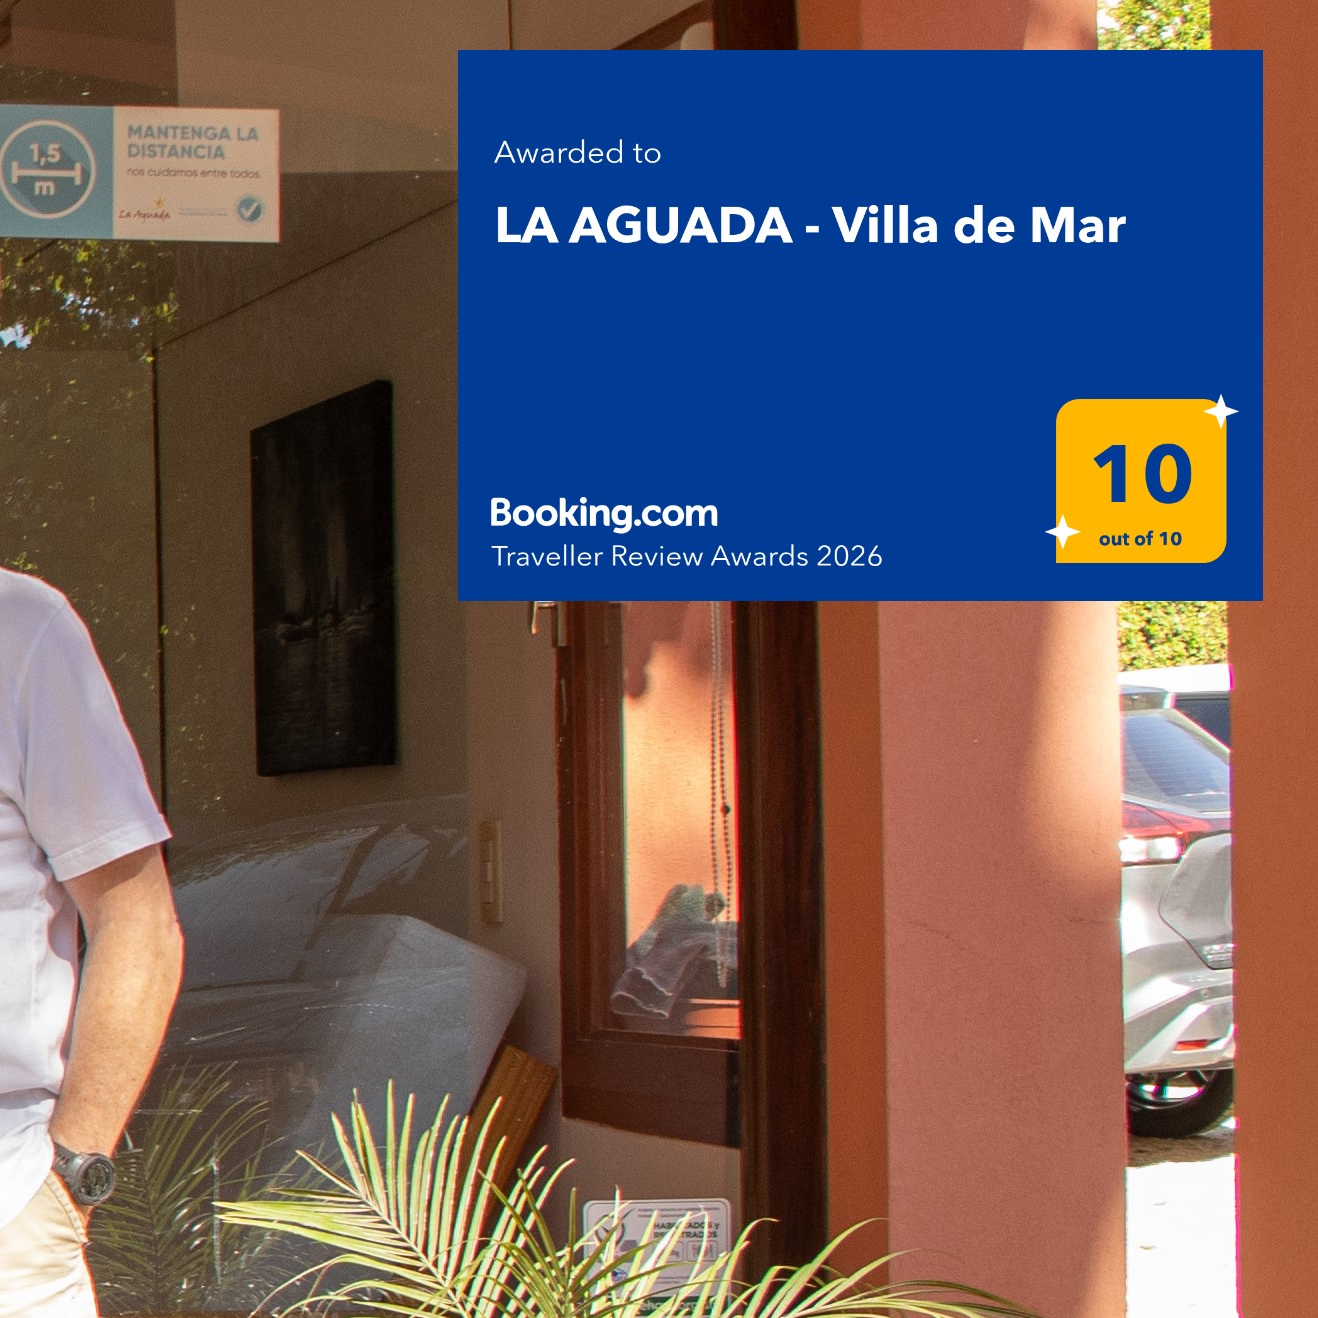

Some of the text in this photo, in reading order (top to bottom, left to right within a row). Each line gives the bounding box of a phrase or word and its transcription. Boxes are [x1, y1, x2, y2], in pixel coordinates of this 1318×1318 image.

[128, 125, 259, 142] MANTENGA LA
[29, 143, 61, 166] 1,5
[127, 143, 226, 159] DISTANCIA
[127, 167, 261, 179] nos cuidamos entre todos
[34, 180, 56, 196] m
